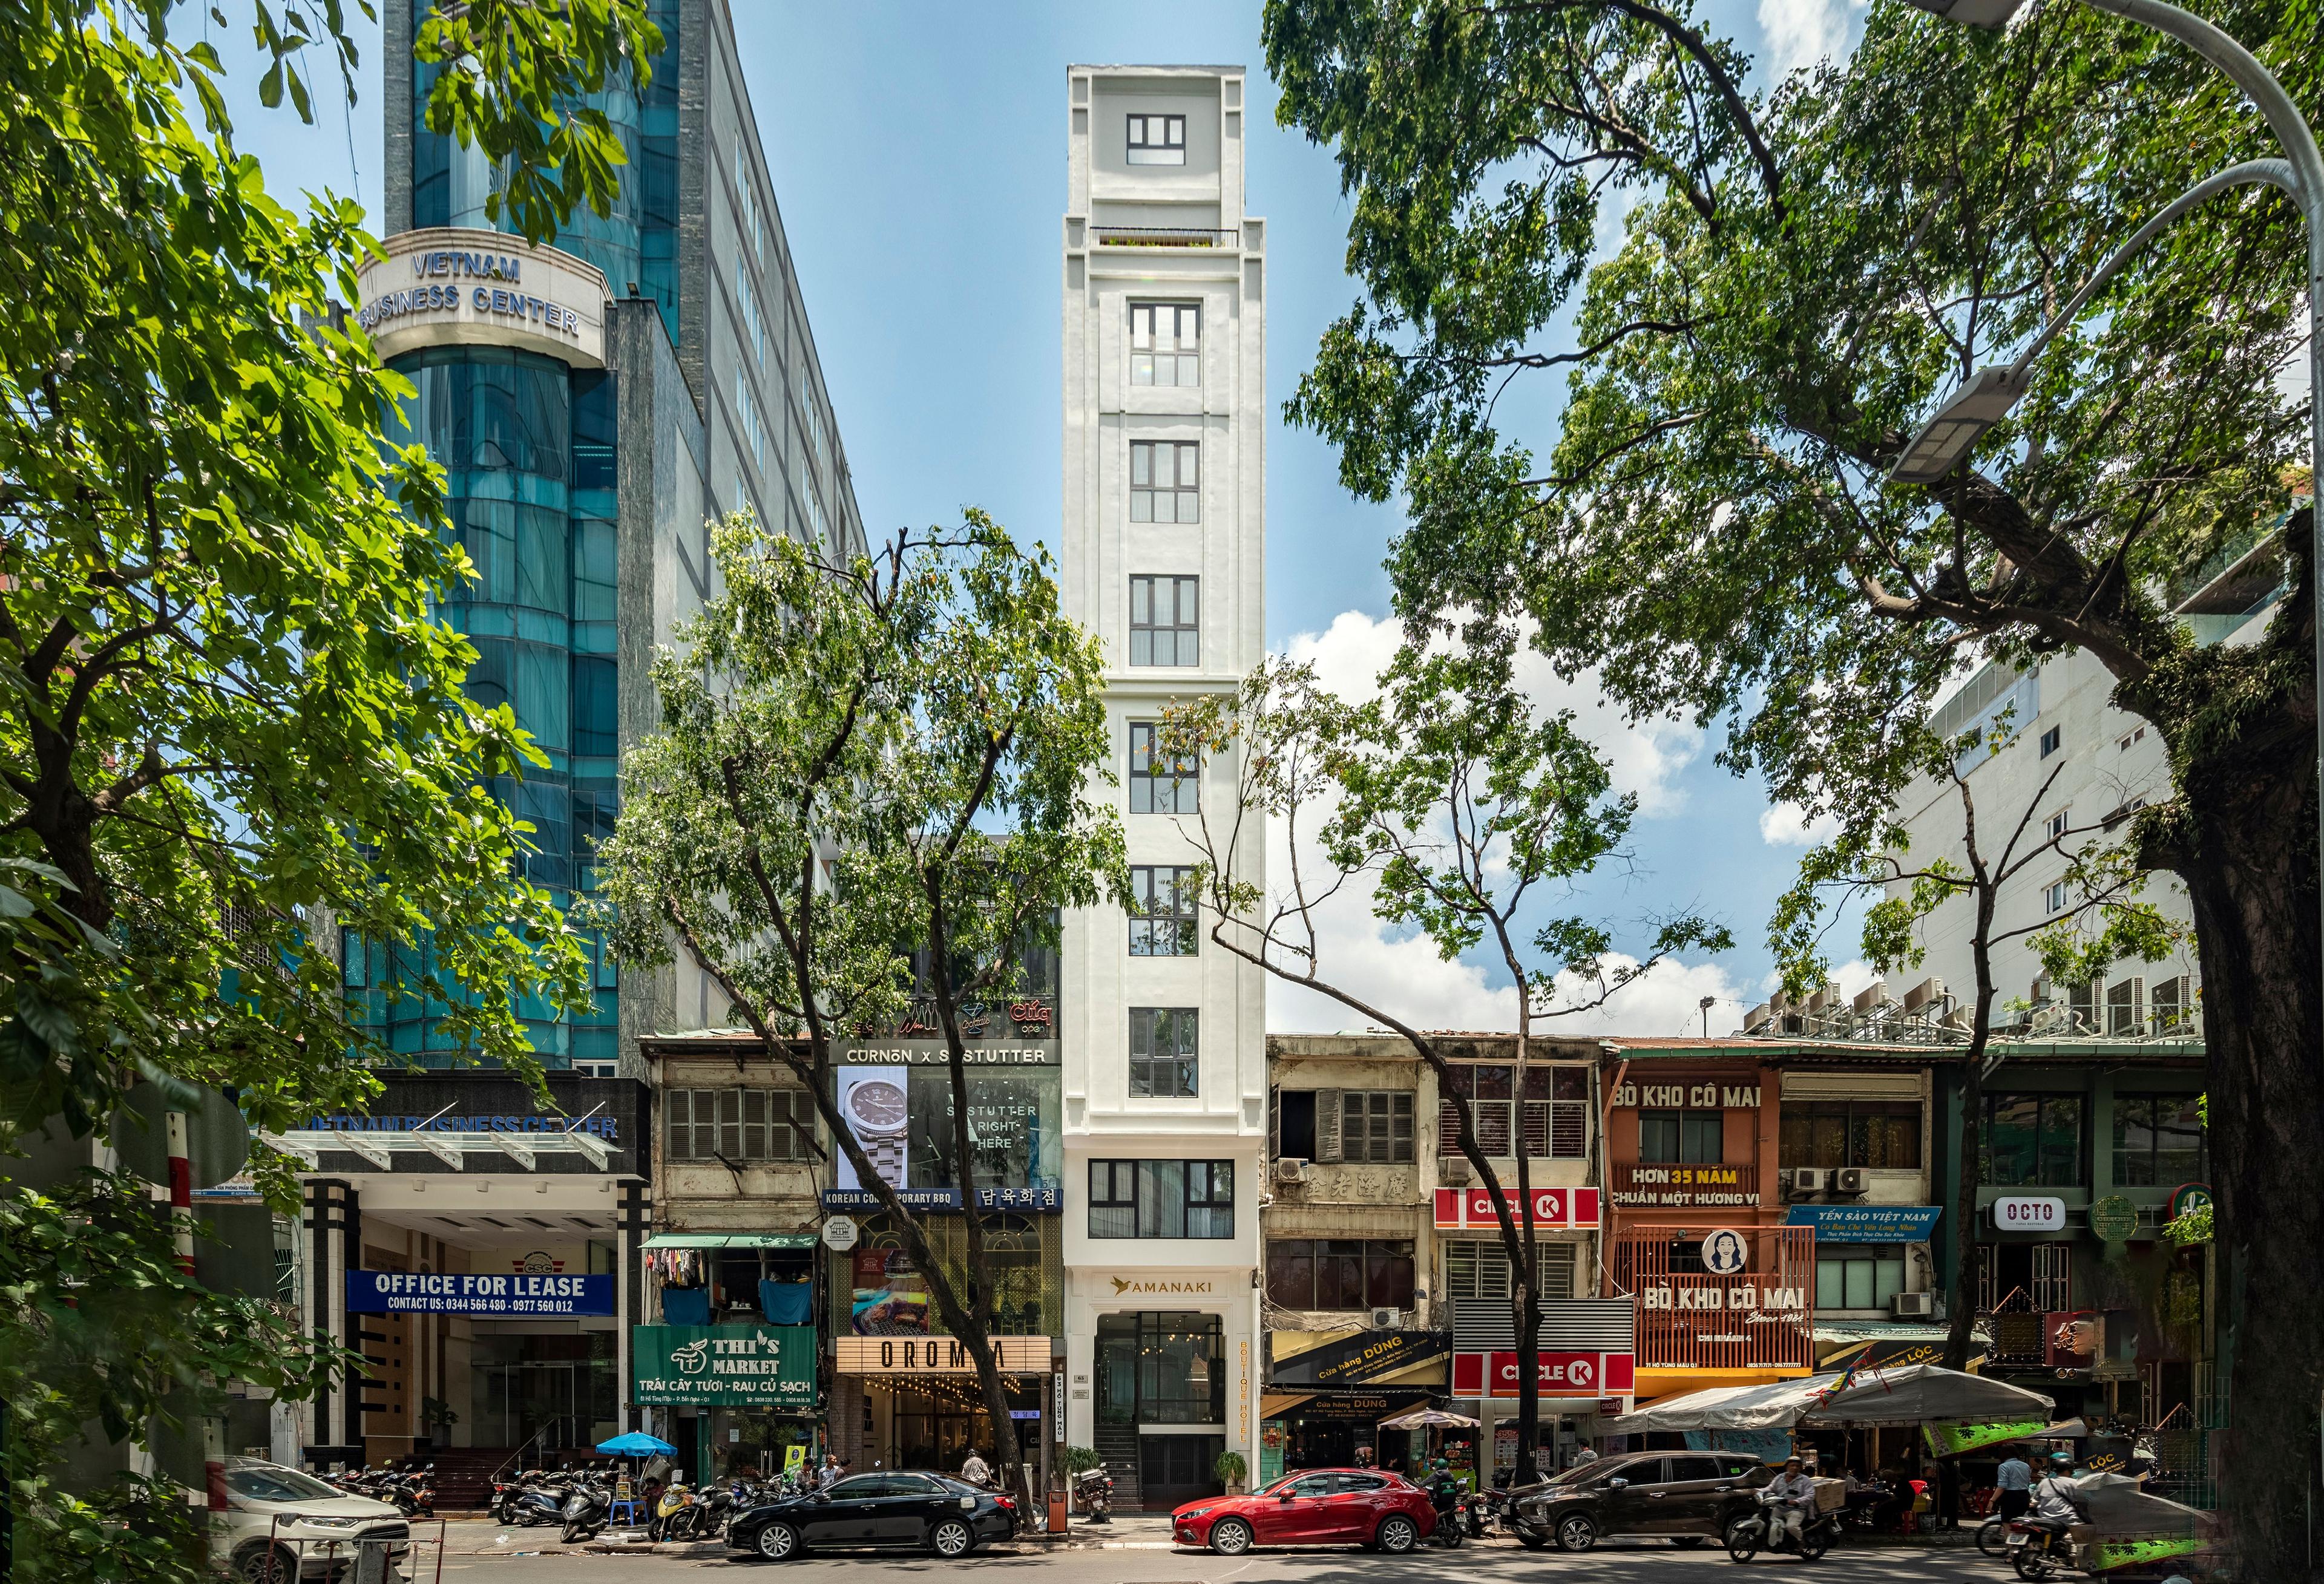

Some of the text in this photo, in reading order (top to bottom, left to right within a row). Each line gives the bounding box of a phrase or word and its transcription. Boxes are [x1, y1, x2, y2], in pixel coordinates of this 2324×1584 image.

[412, 252, 520, 283] VIETNAM
[359, 286, 579, 336] BUSINESS CENTER
[899, 1017, 924, 1033] Wine
[962, 1015, 990, 1029] Cocktails
[939, 1049, 1045, 1062] SSTUTTER
[1612, 1081, 1761, 1107] BÒ KHO CÔ MAI
[947, 1106, 1036, 1116] SSTUTTER
[298, 1116, 399, 1131] IETNAM
[523, 1116, 617, 1138] CETER
[977, 1122, 1016, 1131] RIGHT
[977, 1139, 1012, 1148] HERE
[1632, 1167, 1737, 1183] HƠN 35 NĂM
[826, 1194, 950, 1204] KOREAN CONPORARY BBQ
[1612, 1185, 1760, 1206] CHUẨN MỘT HƯƠNG VỊ
[1474, 1197, 1558, 1216] CICL K
[2007, 1203, 2053, 1220] OCTO
[1819, 1209, 1842, 1220] YẾN
[1845, 1210, 1869, 1221] SÀO
[1873, 1213, 1900, 1223] VIỆT
[524, 1263, 553, 1274] CSC
[375, 1274, 585, 1297] OFFICE FOR LEASE
[1132, 1282, 1211, 1292] AMANAKI
[1644, 1281, 1804, 1309] BÒ KHO CÔ MAI
[388, 1297, 573, 1312] CONTACT US: 0344 566 480 0977 560 012
[881, 1340, 1004, 1367] OROMA
[1319, 1337, 1403, 1379] Cửa hàng DŨNG
[1907, 1346, 1932, 1361] LỘC
[712, 1360, 780, 1374] MARKET
[1502, 1363, 1590, 1384] CICLE K
[639, 1378, 810, 1394] TRÁI CÂY TƯƠI RAU CỦ SẠCH
[1057, 1376, 1062, 1386] 63
[1354, 1399, 1387, 1407] DŨNG
[1616, 1400, 1621, 1410] K
[2089, 1453, 2115, 1470] LỘC
